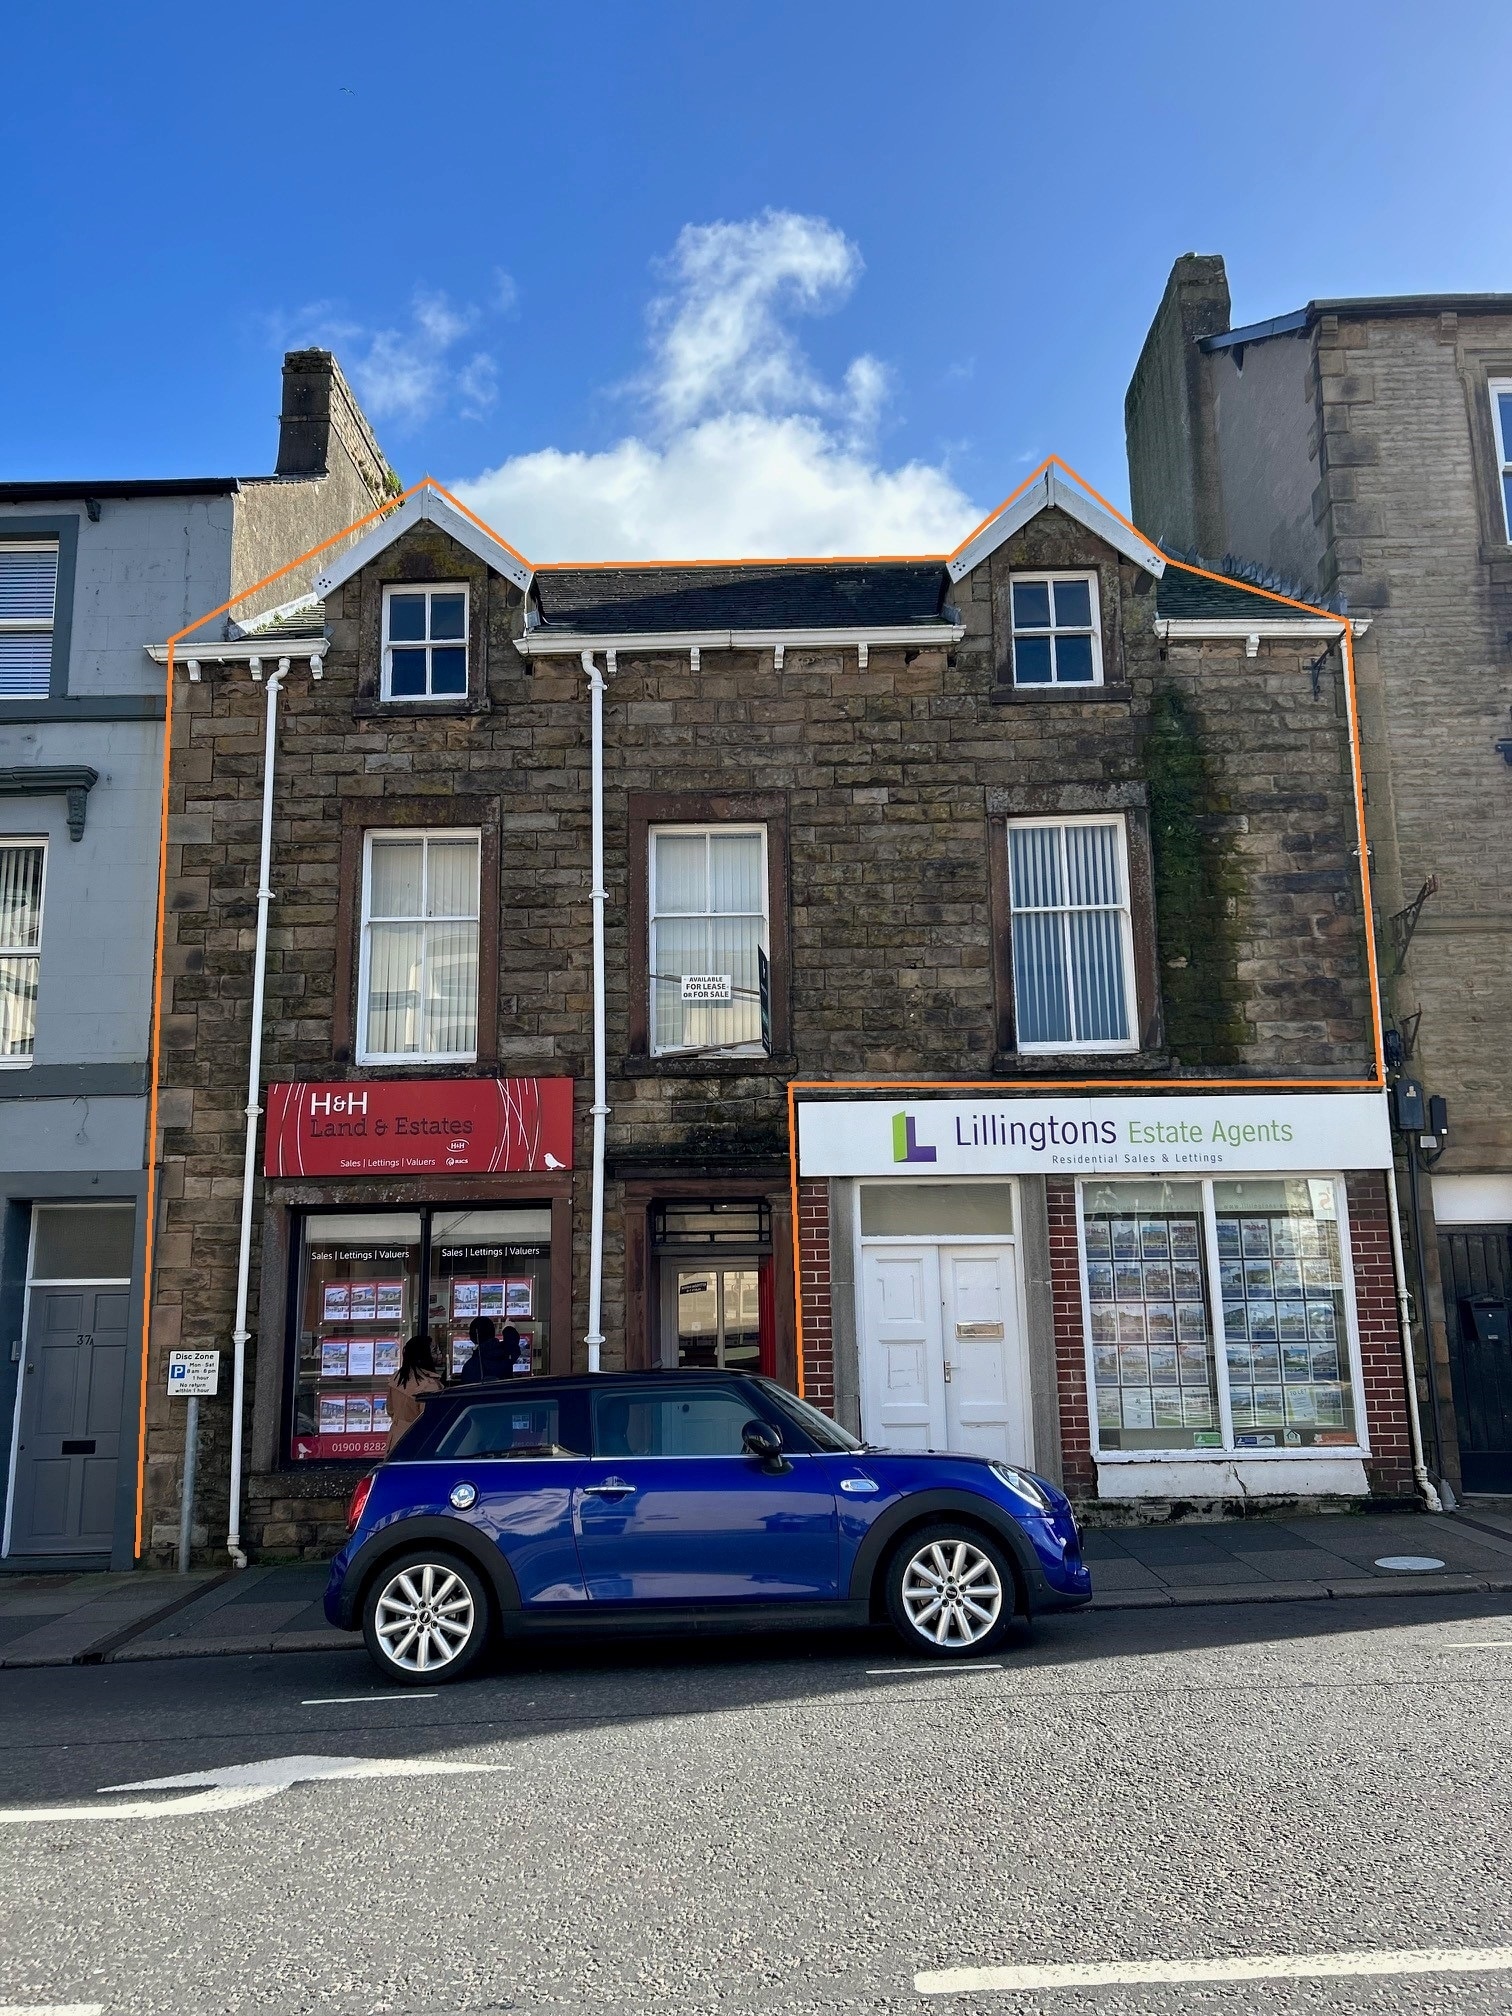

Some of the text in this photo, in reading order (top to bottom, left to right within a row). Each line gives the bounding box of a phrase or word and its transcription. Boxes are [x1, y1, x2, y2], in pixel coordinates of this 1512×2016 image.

[310, 1091, 368, 1116] H&H
[310, 1117, 473, 1137] Land & Estates
[955, 1114, 1293, 1151] Lillingtons Estate Agents
[340, 1160, 361, 1168] Sales
[368, 1158, 400, 1168] Lettings
[406, 1158, 436, 1166] Valuers
[1052, 1153, 1223, 1164] Residential Sales & Lettings
[311, 1252, 332, 1260] Sales
[340, 1250, 372, 1260] Lettings
[379, 1250, 410, 1258] Valuers
[442, 1248, 463, 1257] Sales
[470, 1248, 503, 1258] Lettings
[510, 1246, 540, 1255] Valuers
[77, 1335, 94, 1345] 37A
[332, 1442, 386, 1452] 01900 8282
